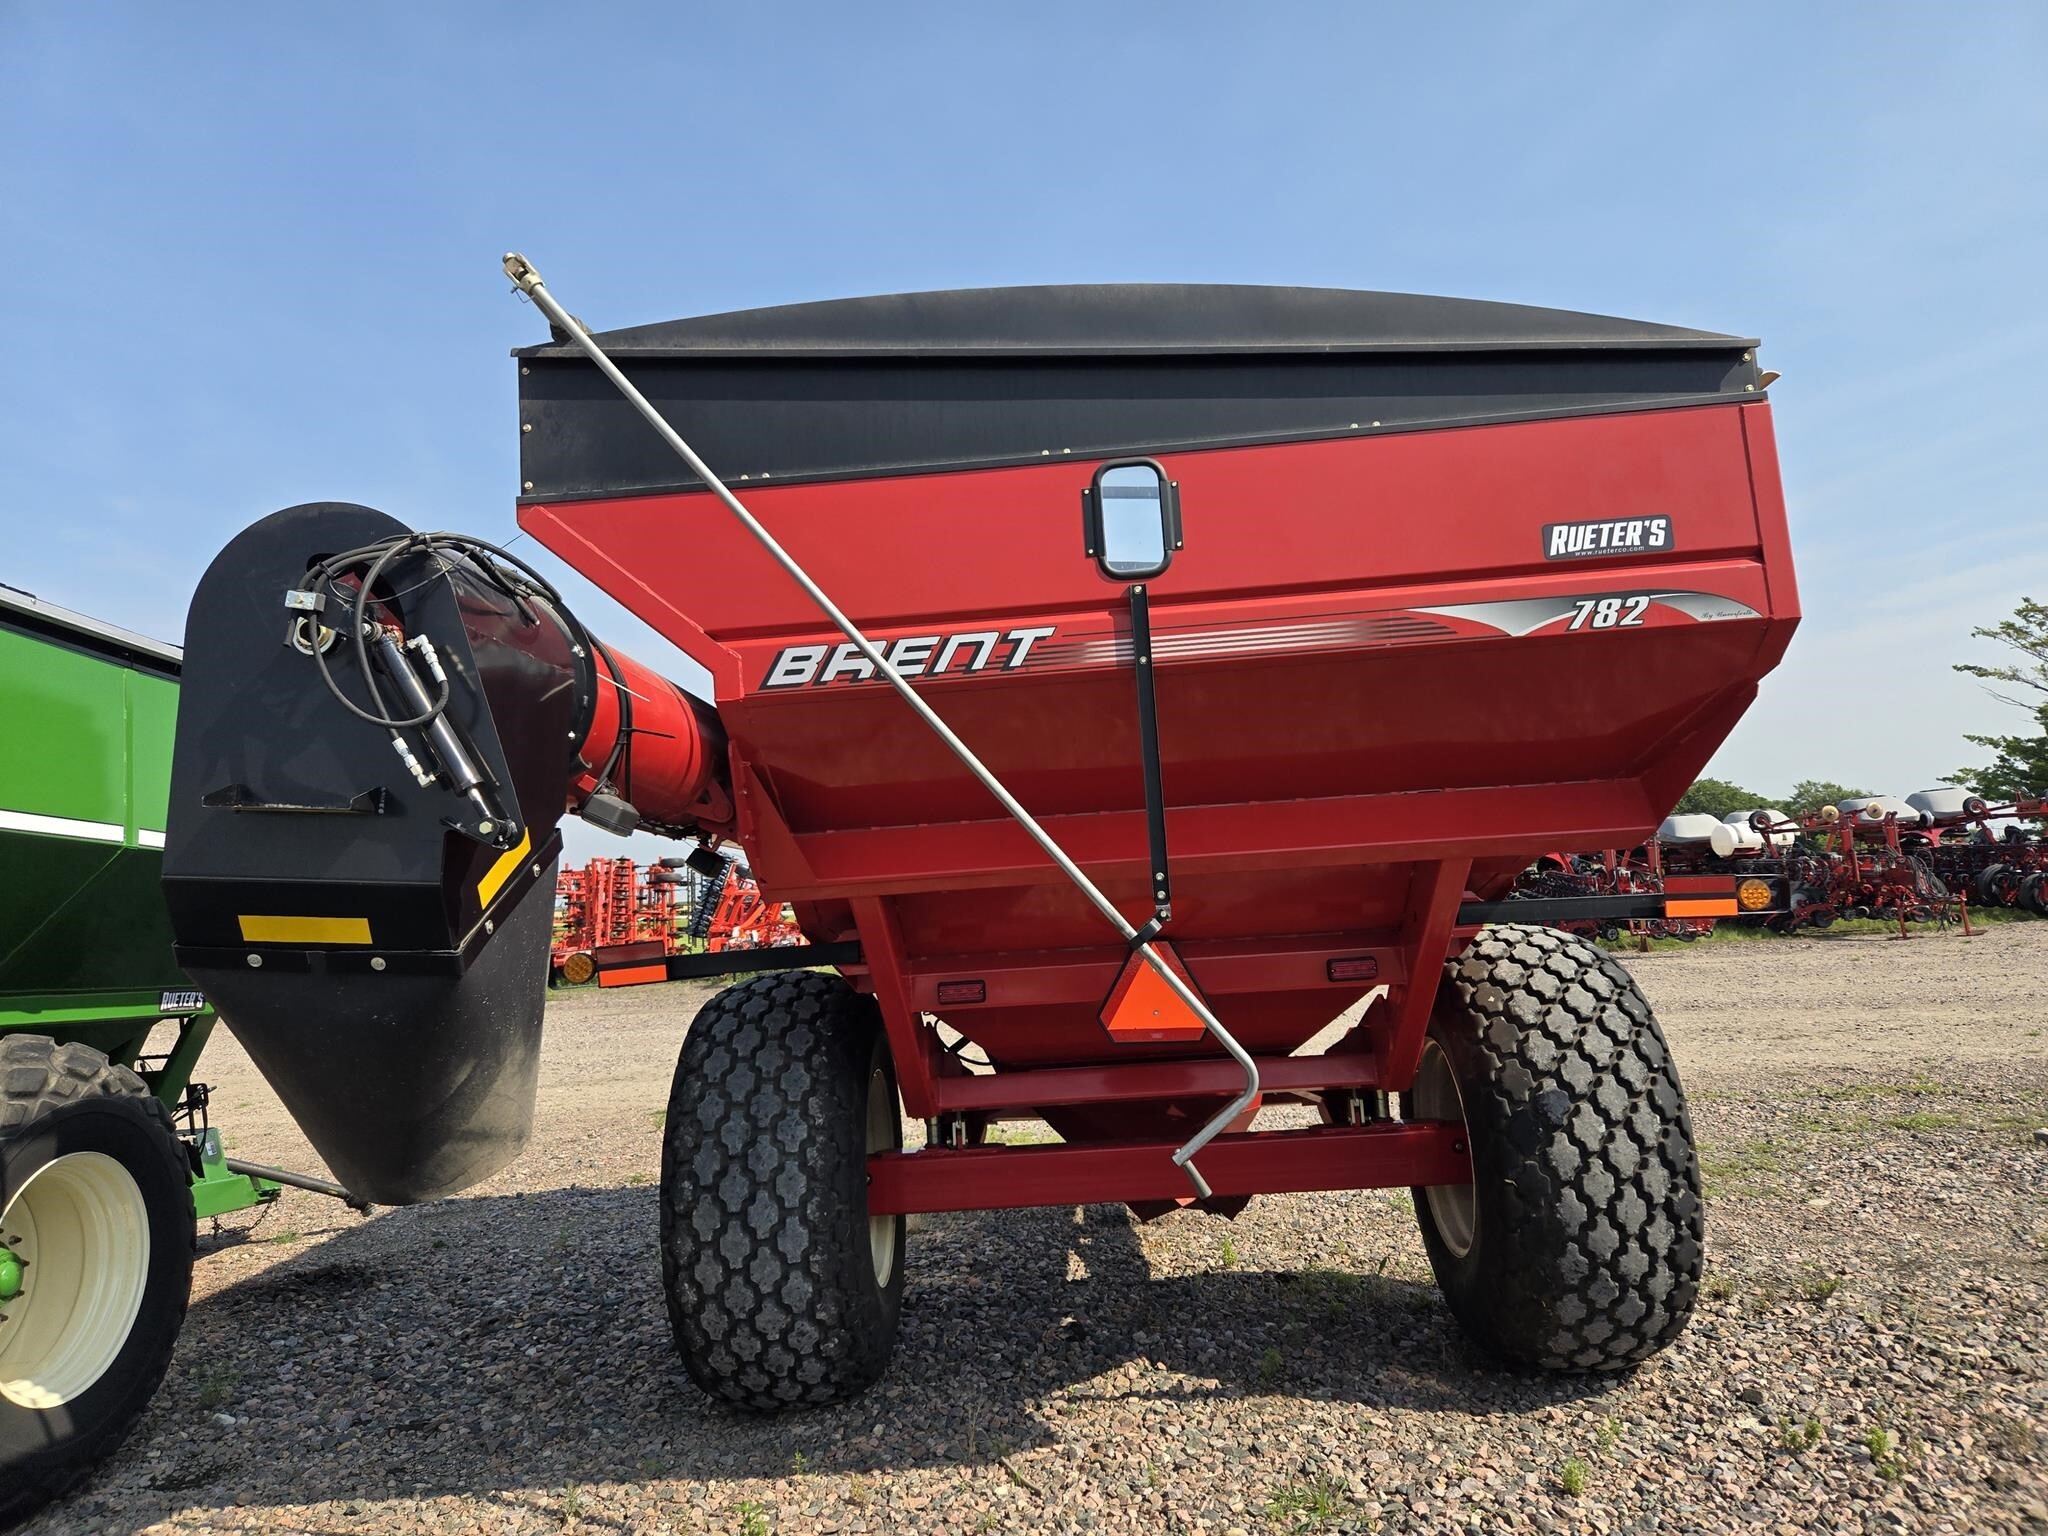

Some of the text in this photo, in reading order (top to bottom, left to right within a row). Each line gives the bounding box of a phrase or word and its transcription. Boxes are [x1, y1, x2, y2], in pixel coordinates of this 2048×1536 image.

[1550, 519, 1666, 555] RUETER'S
[1575, 545, 1644, 556] www.rueterco.com
[1569, 596, 1649, 630] 782
[762, 627, 1056, 688] BRENT
[161, 992, 204, 1010] RUETER'S
